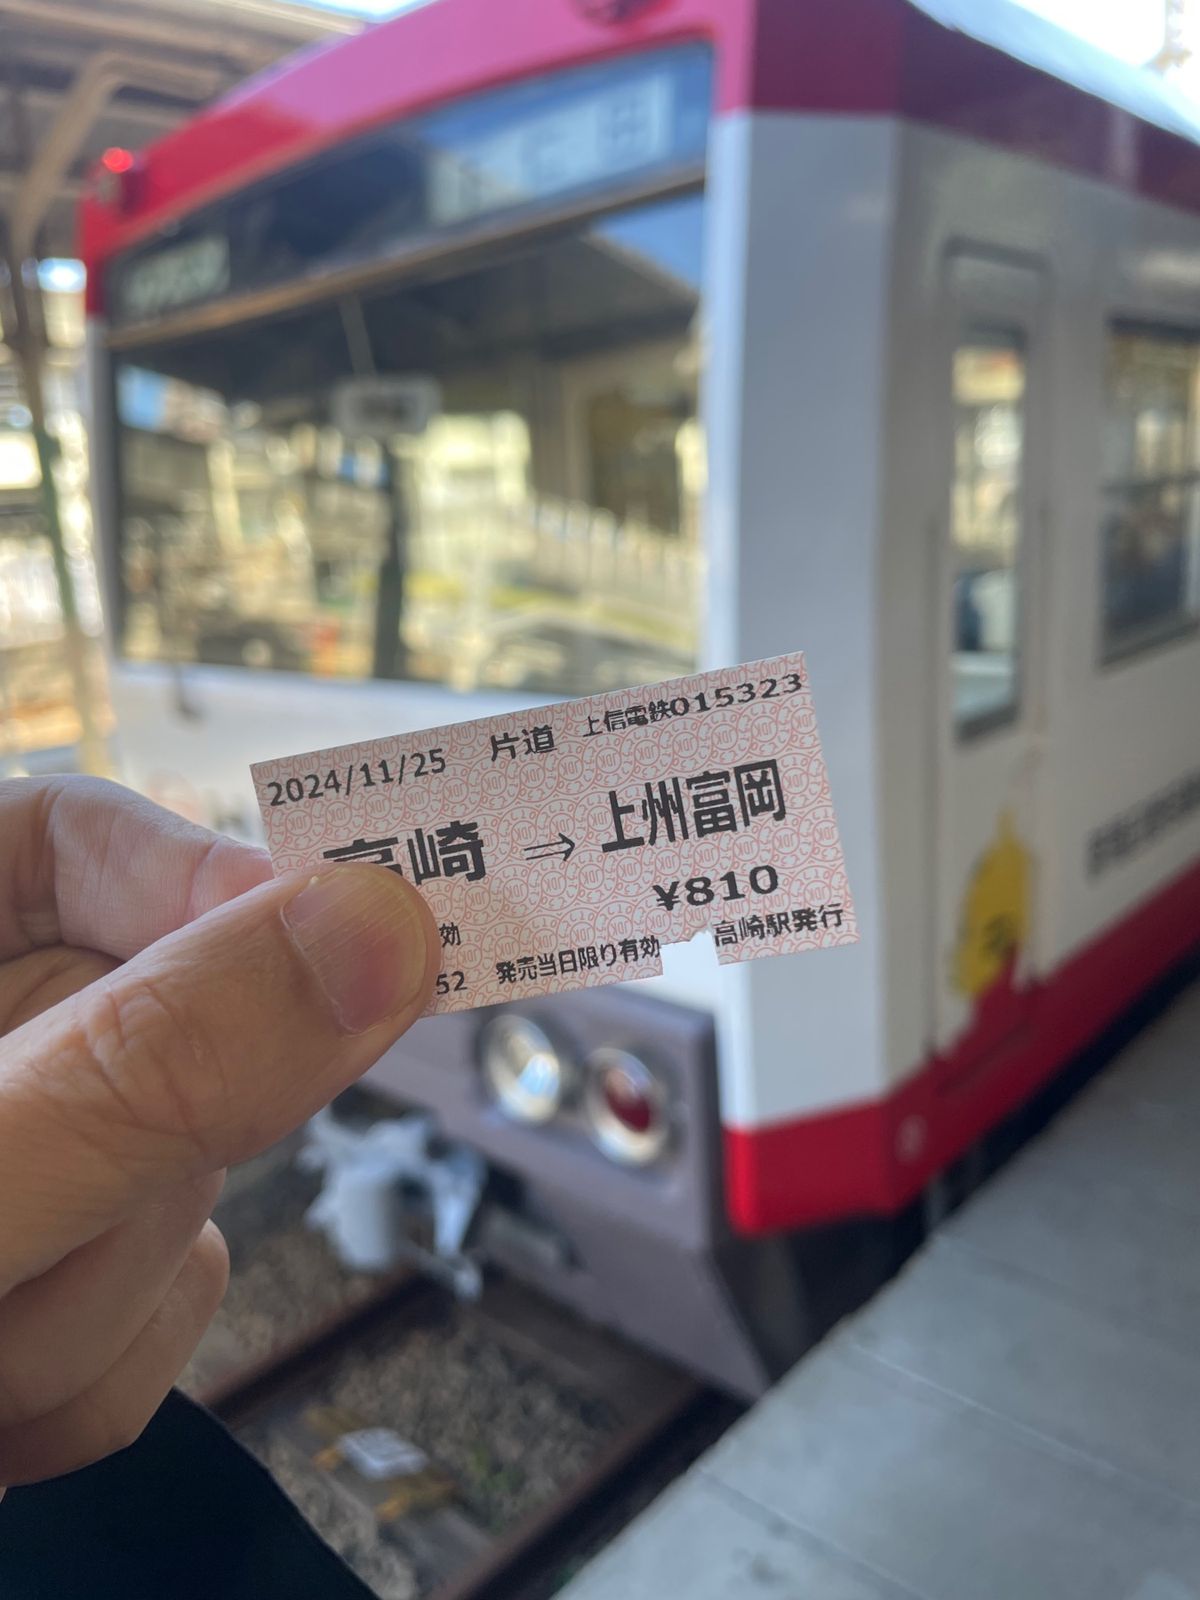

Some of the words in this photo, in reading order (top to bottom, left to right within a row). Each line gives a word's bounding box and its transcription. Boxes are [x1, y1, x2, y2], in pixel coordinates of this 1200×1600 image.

[489, 725, 557, 761] 片道
[267, 748, 447, 806] 2024/11/25
[602, 758, 786, 853] 上州富岡
[653, 865, 779, 911] ¥810
[713, 903, 844, 947] 高崎駅発行
[495, 935, 661, 985] 発売当日限り有効
